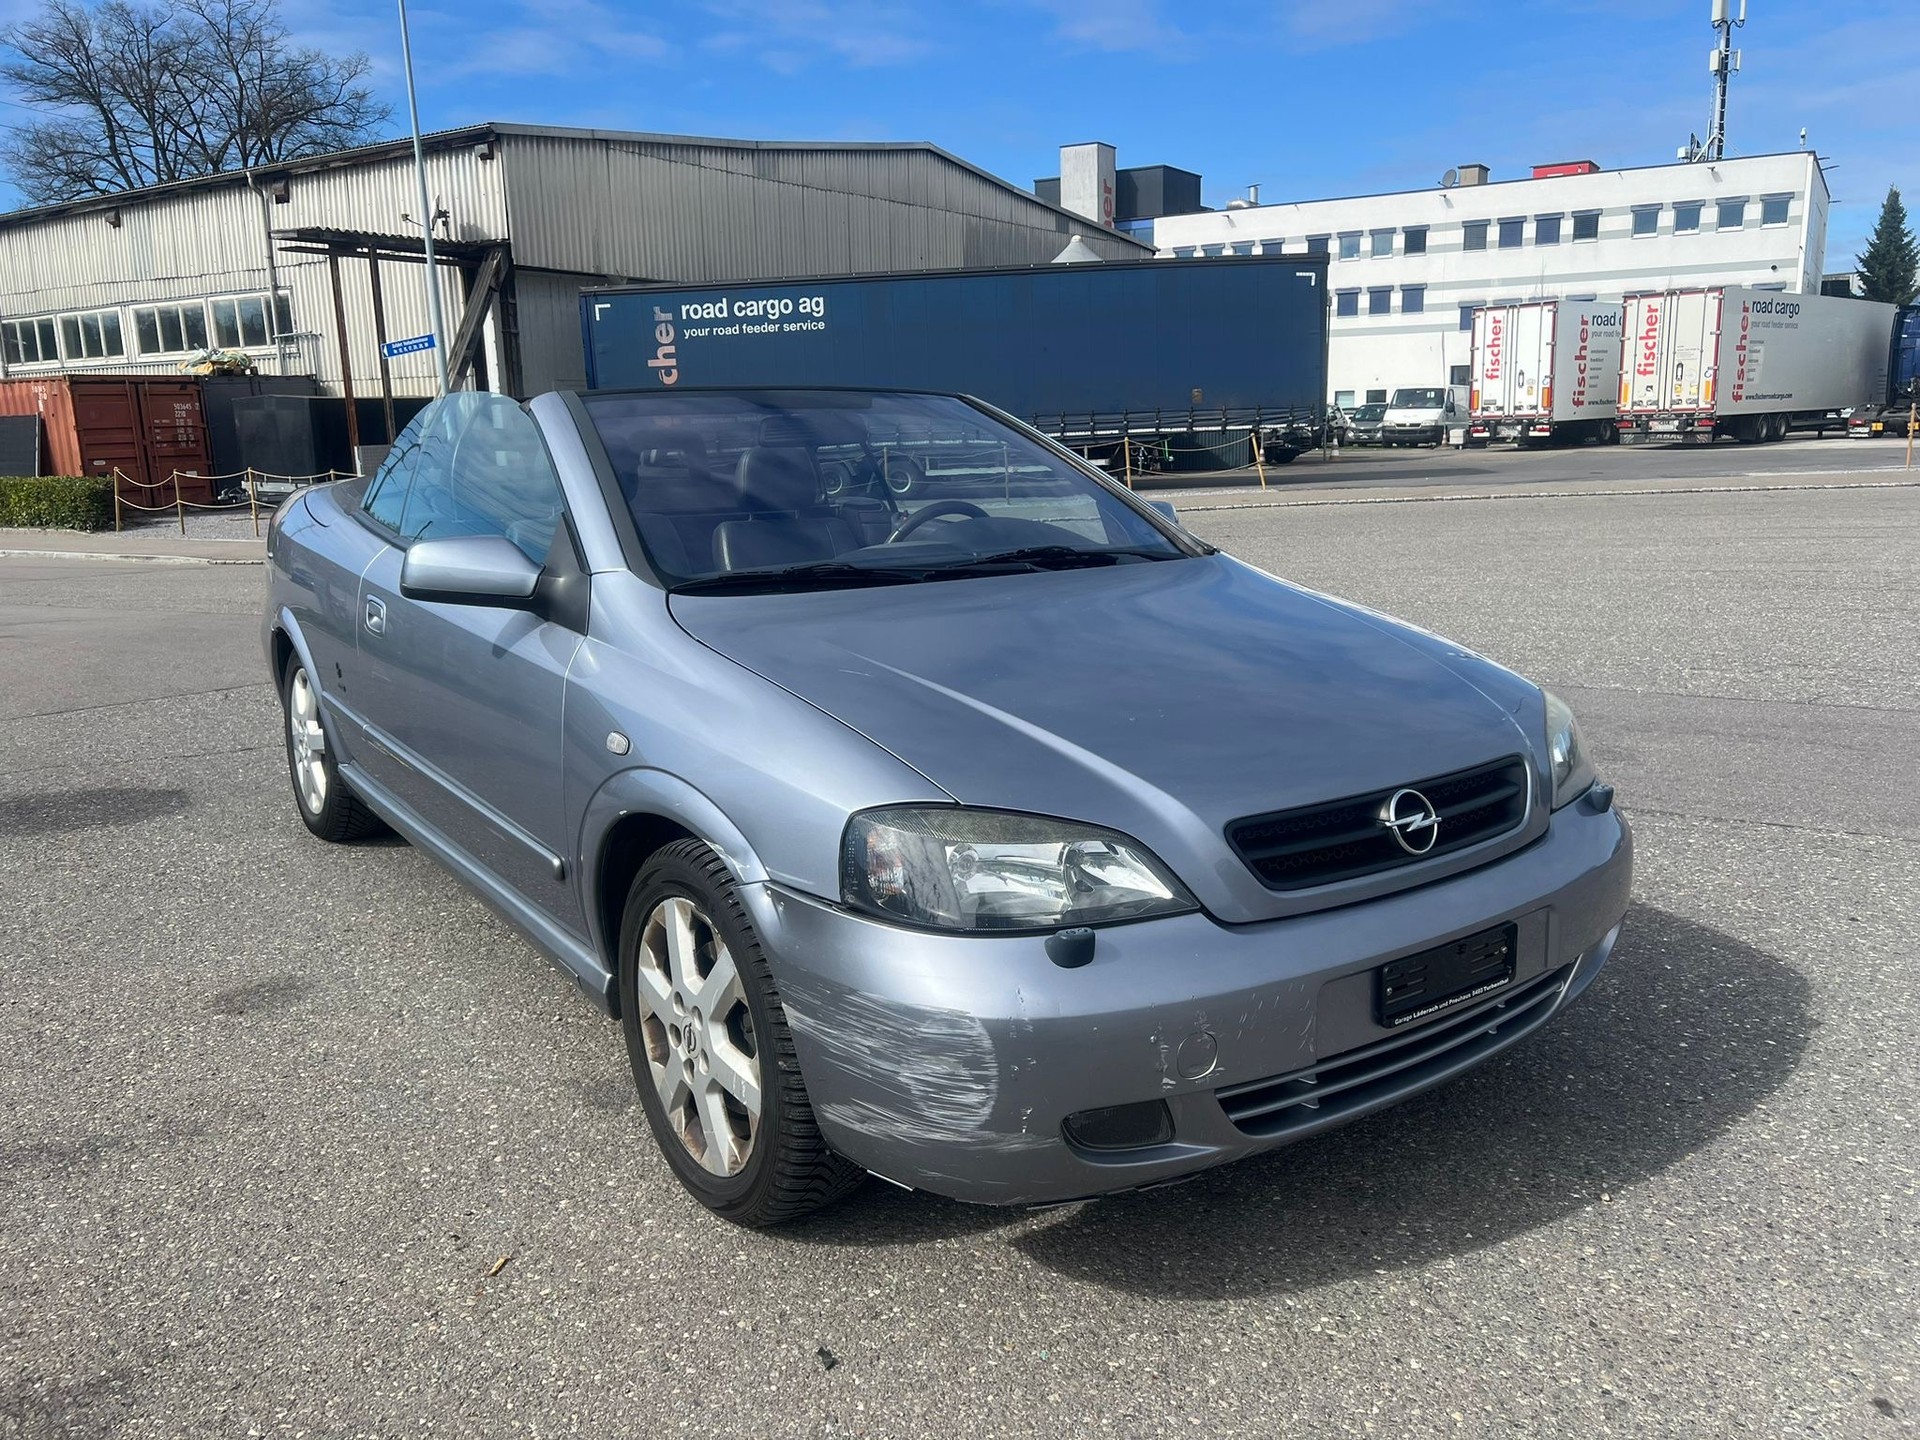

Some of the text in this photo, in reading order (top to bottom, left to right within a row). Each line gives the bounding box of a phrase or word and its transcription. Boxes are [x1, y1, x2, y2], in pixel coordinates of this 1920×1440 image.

[681, 296, 825, 320] road cargo ag
[683, 319, 826, 339] your road feeder service
[1592, 311, 1617, 327] road
[1752, 297, 1800, 319] road cargo
[1485, 315, 1502, 380] fischer
[1572, 314, 1589, 408] fischer
[1636, 304, 1659, 377] fischer
[1732, 300, 1750, 403] fischer
